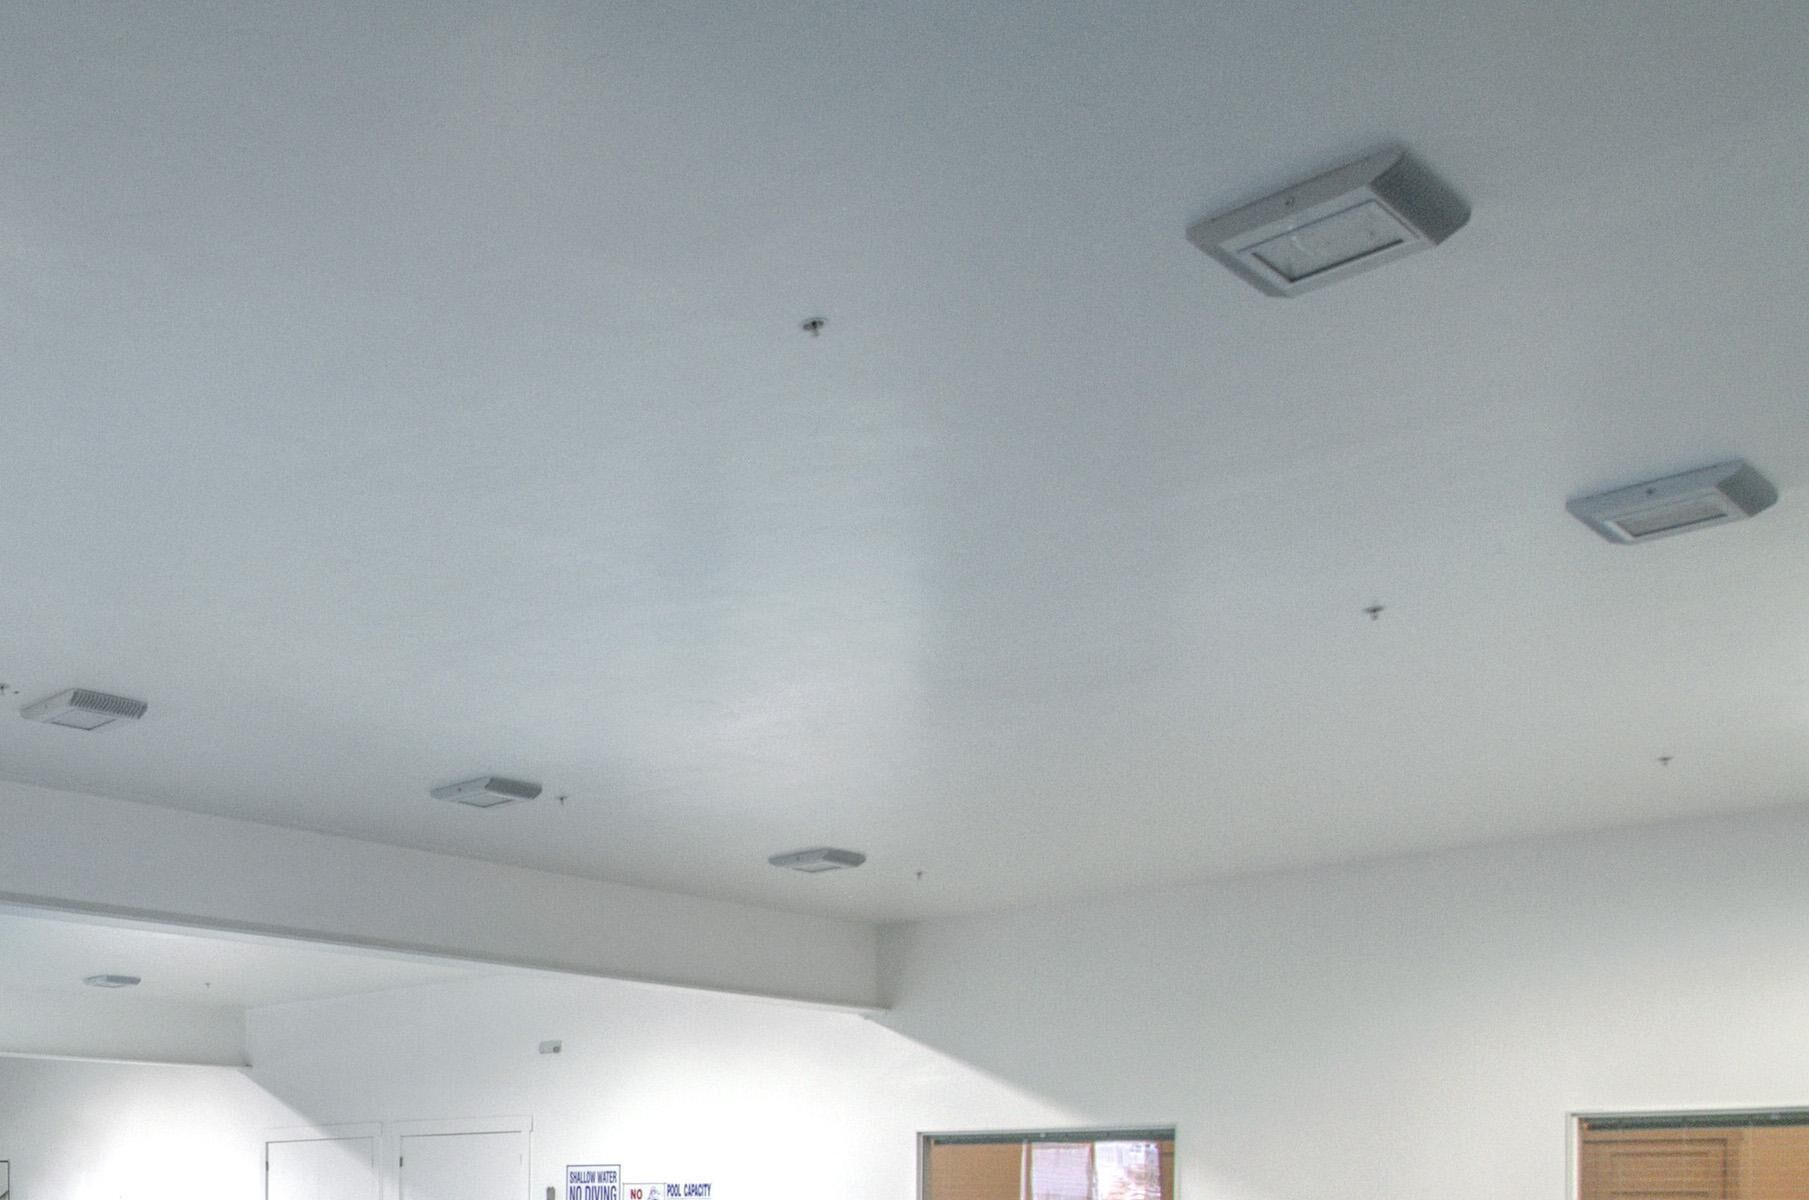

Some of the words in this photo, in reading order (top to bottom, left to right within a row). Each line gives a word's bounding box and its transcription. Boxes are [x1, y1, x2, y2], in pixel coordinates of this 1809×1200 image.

[569, 1171, 595, 1184] SHALLOW
[597, 1170, 617, 1184] WATER
[630, 1189, 643, 1200] NO
[667, 1184, 681, 1197] POOL
[684, 1184, 711, 1197] CAPACITY
